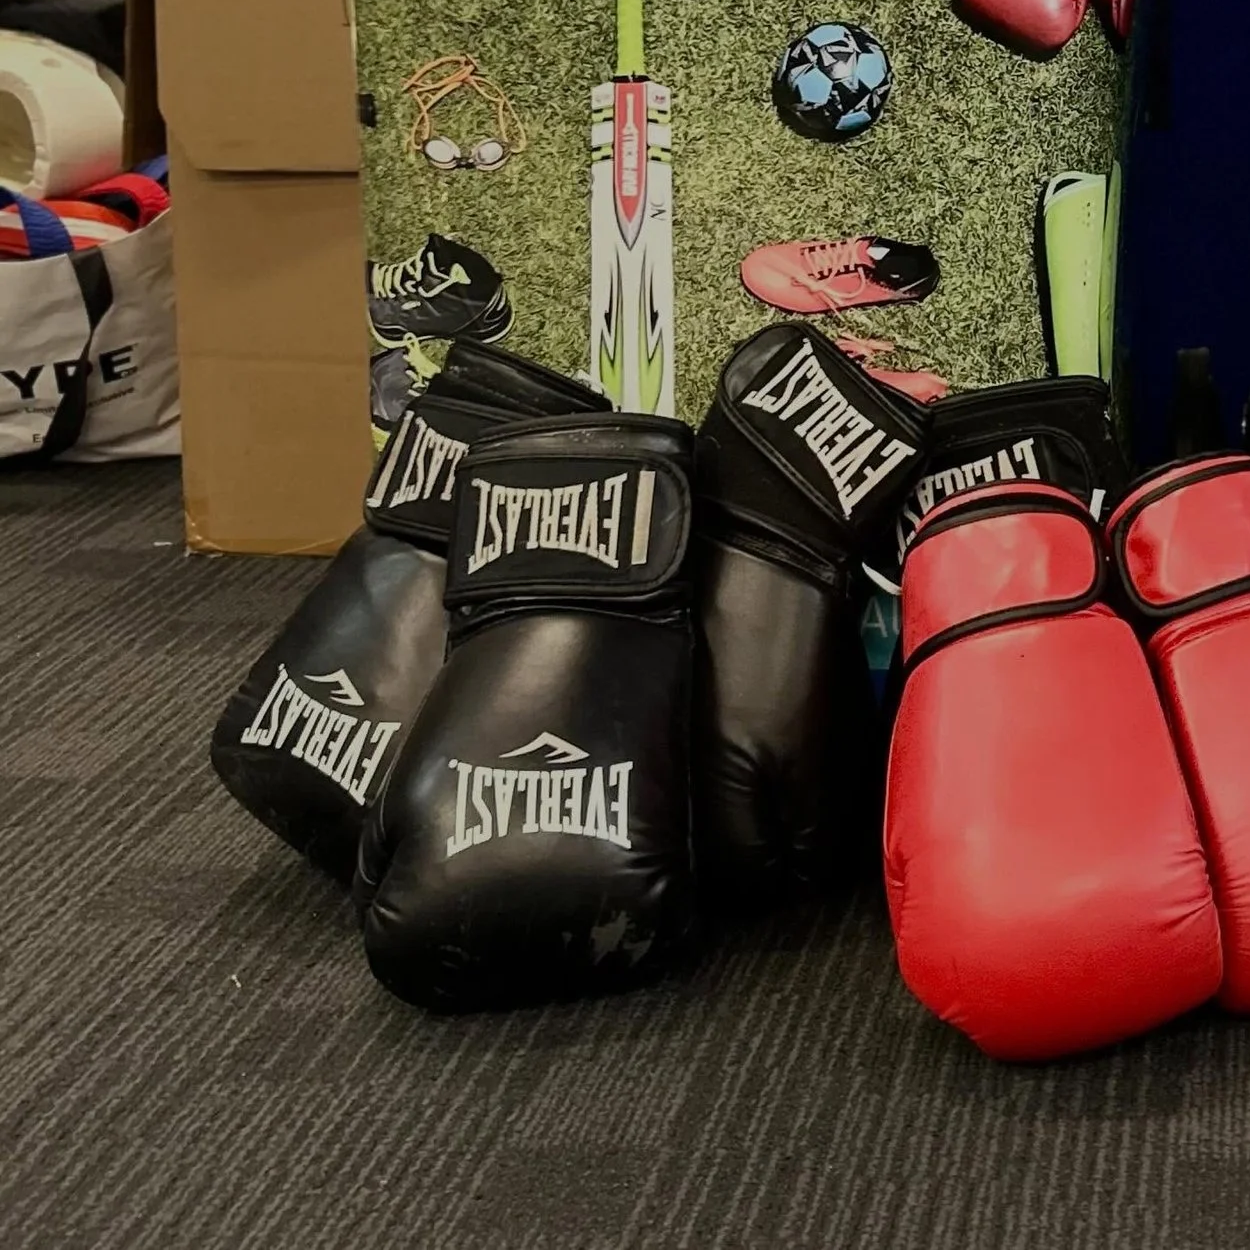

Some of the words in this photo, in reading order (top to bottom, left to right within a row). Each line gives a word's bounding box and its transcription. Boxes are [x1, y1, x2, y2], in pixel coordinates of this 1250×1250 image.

[742, 338, 916, 518] EVERLAST
[468, 473, 627, 573] EVERLAST
[241, 667, 401, 806] EVERLAST
[447, 759, 633, 857] EVERLAST
